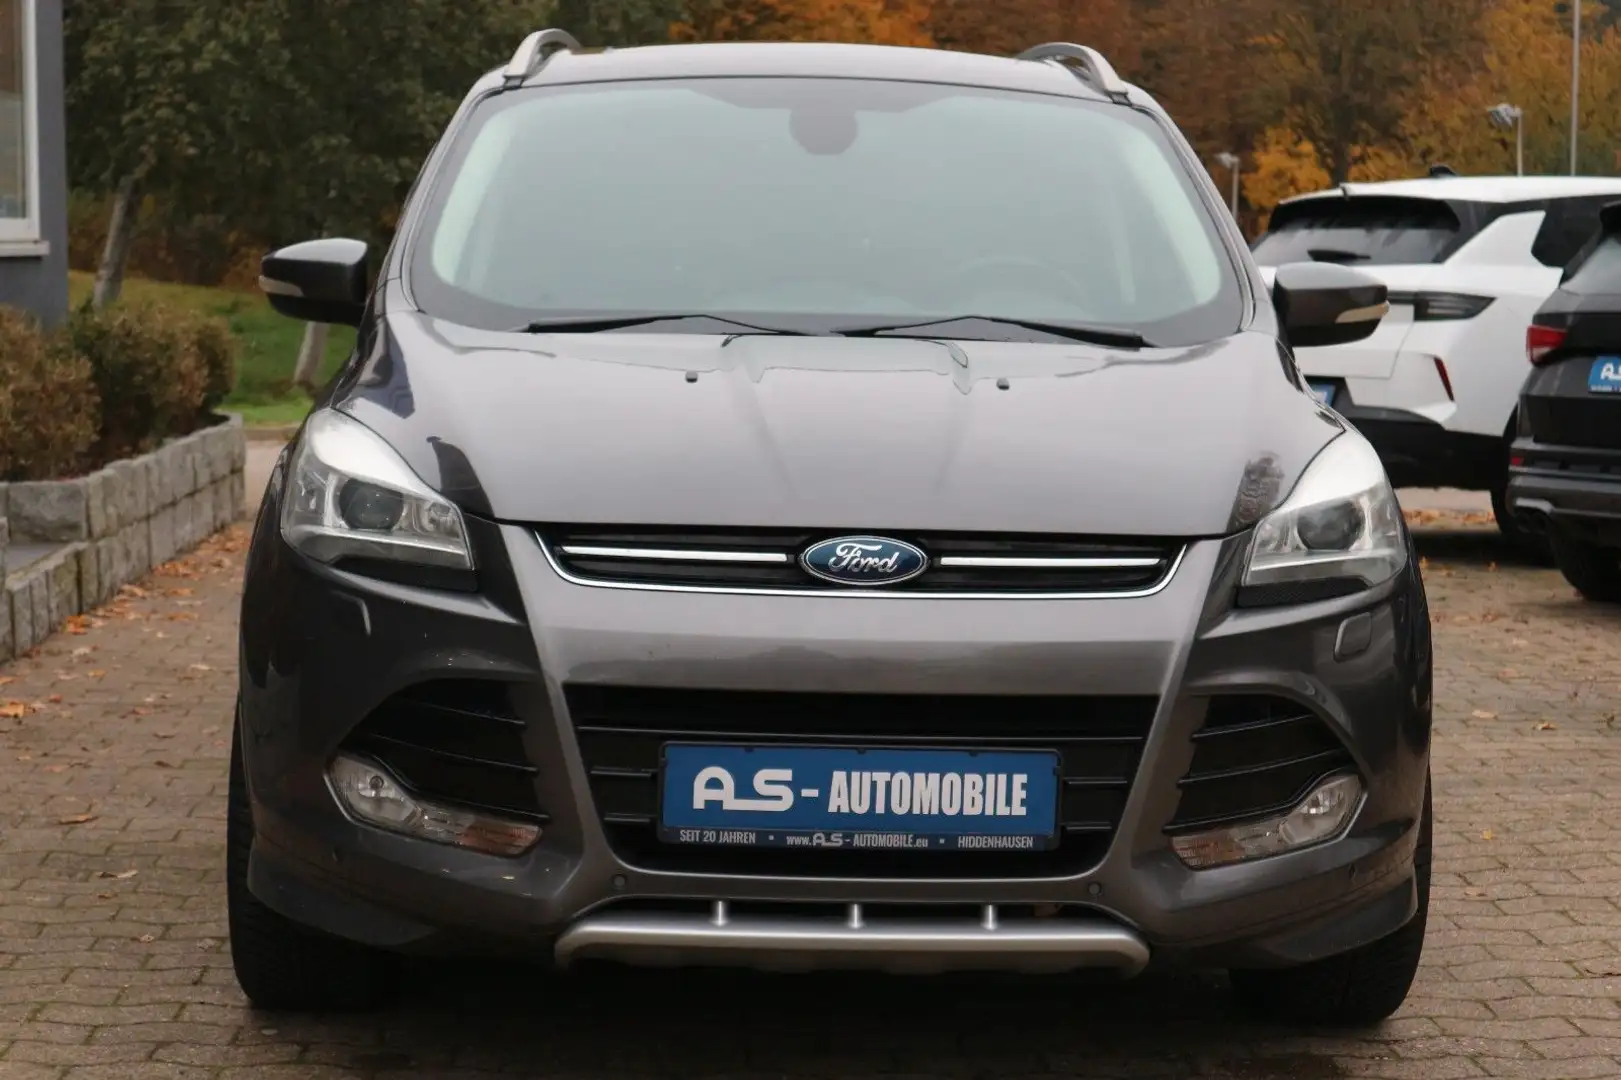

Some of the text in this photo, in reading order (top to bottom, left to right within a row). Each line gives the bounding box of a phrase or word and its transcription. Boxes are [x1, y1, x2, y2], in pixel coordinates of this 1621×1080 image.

[828, 542, 900, 573] Ford
[679, 829, 700, 842] SEIT
[703, 830, 717, 843] 20
[718, 831, 756, 844] JAHREN
[957, 835, 1033, 848] HIDDENHAUSEN
